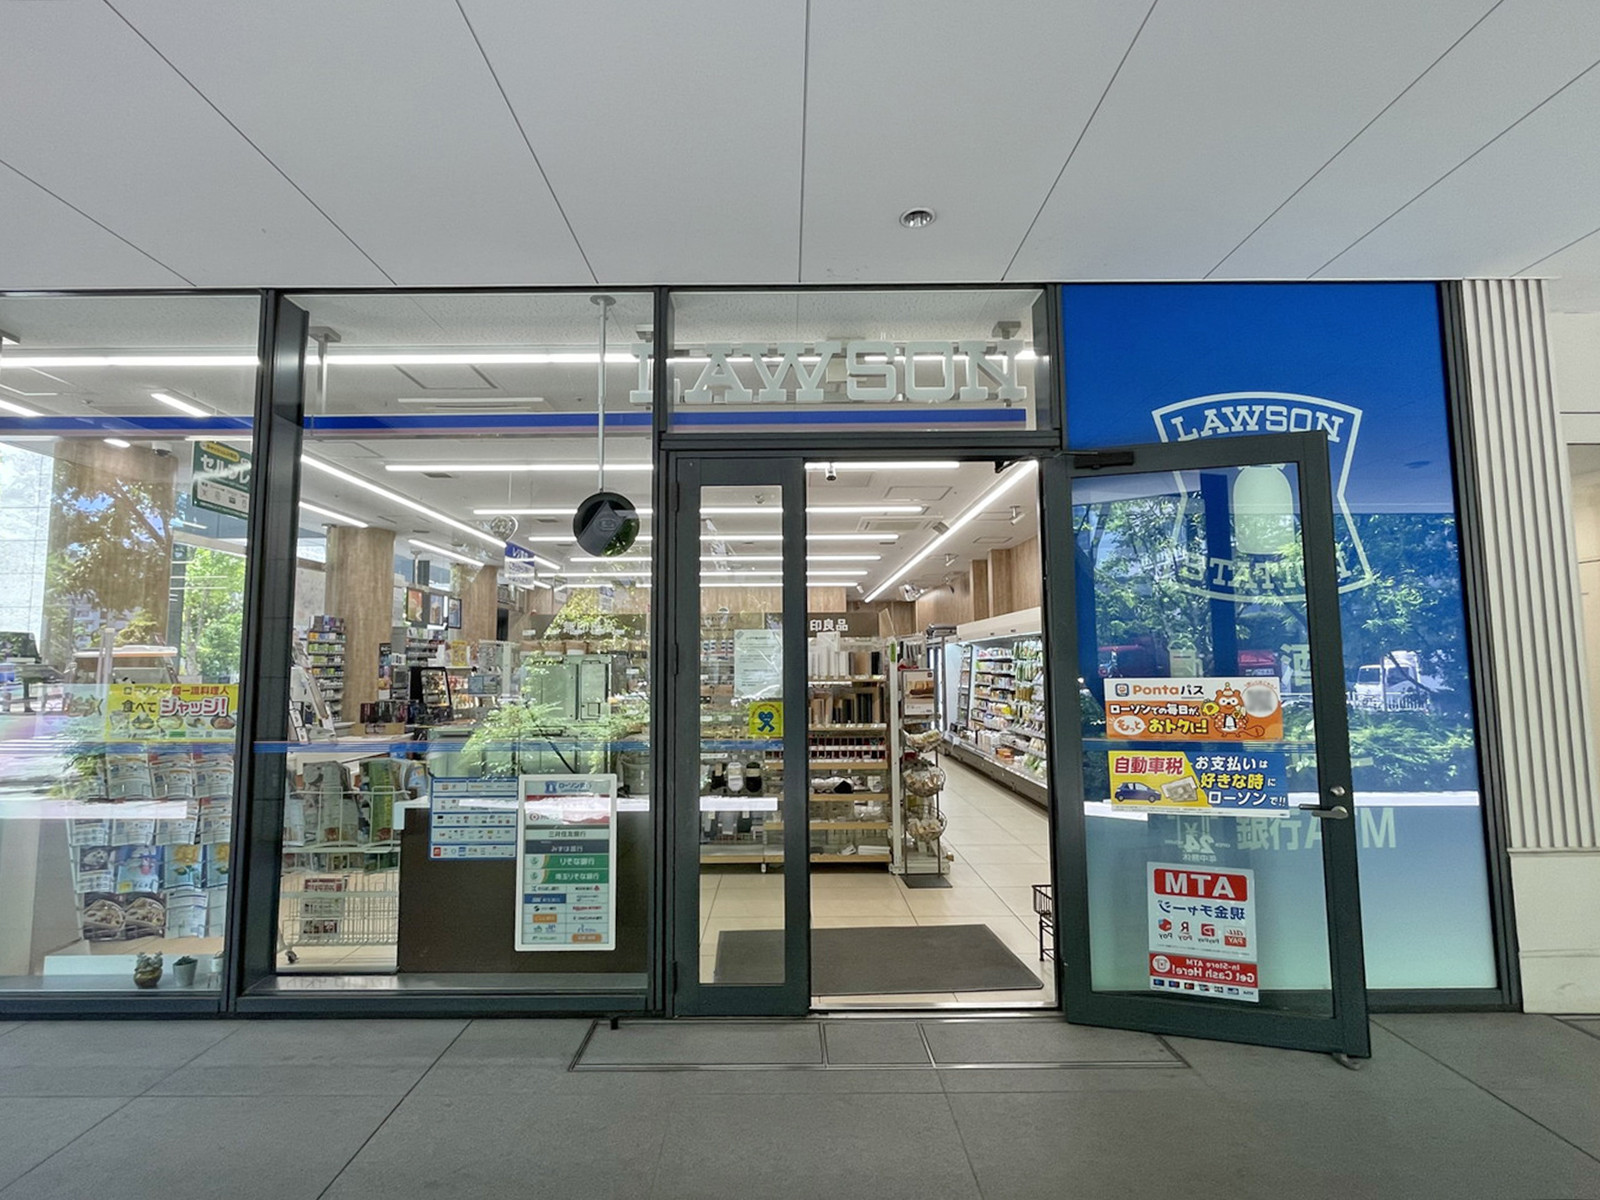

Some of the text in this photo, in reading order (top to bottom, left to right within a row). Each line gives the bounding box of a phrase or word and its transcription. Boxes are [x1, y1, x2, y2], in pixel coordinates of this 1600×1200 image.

[629, 339, 1027, 404] LAWSON
[1170, 405, 1344, 443] LAWSON
[1114, 756, 1184, 775] 自動車税
